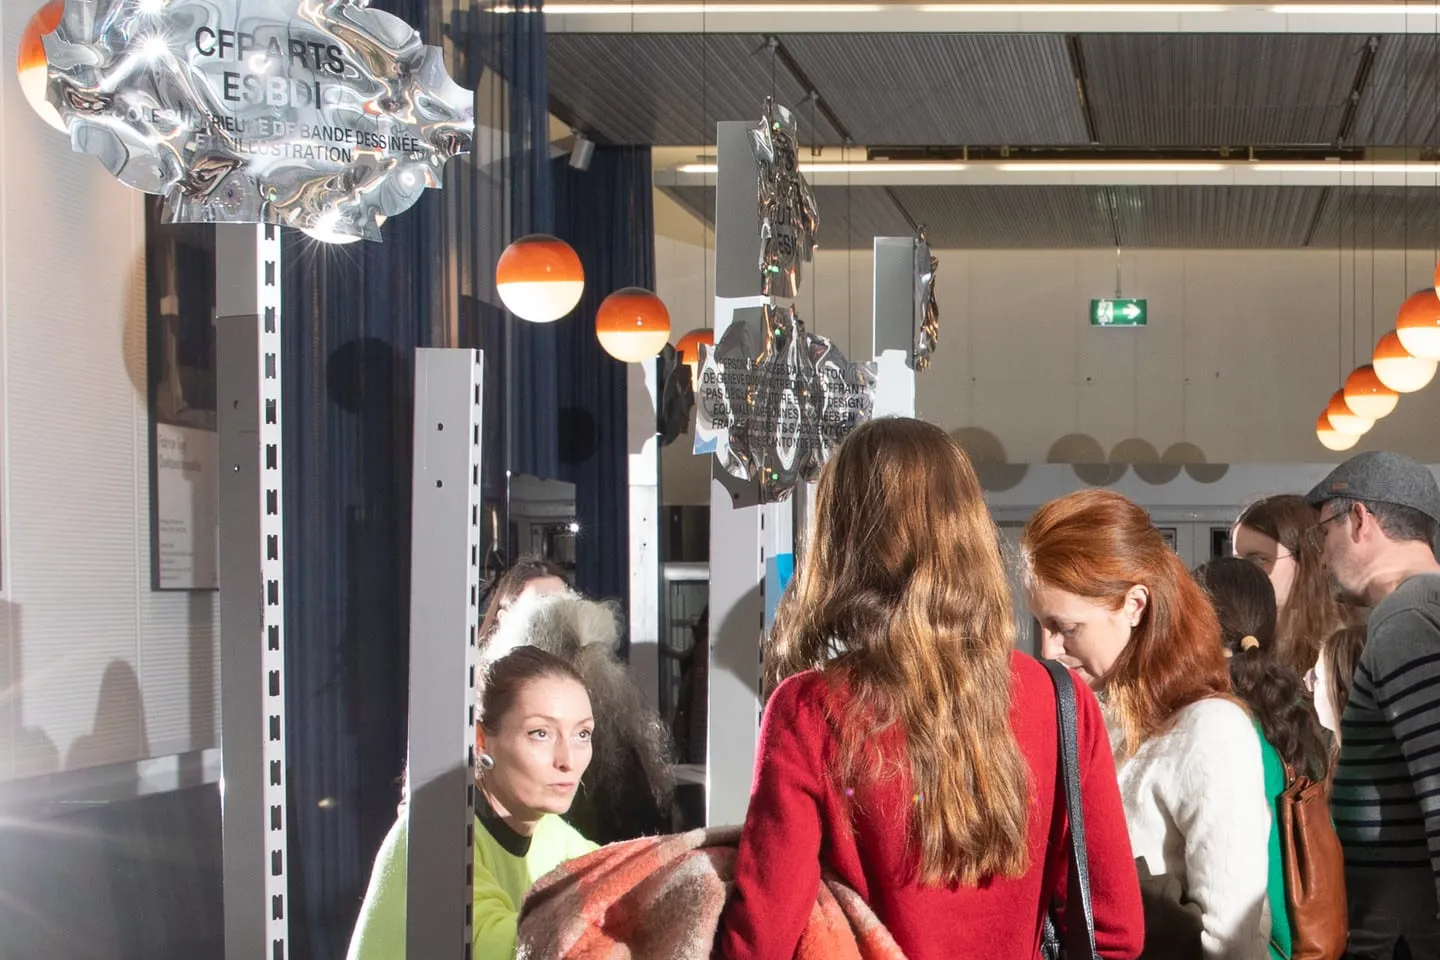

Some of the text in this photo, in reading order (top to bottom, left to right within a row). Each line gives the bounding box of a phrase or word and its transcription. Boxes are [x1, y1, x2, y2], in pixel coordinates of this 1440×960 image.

[195, 26, 345, 74] CFP ARTS
[223, 71, 321, 110] ESBDI
[300, 124, 352, 144] BANDE
[355, 129, 420, 151] DESSINÉE
[706, 387, 724, 401] PAS
[827, 396, 865, 410] DESIGN
